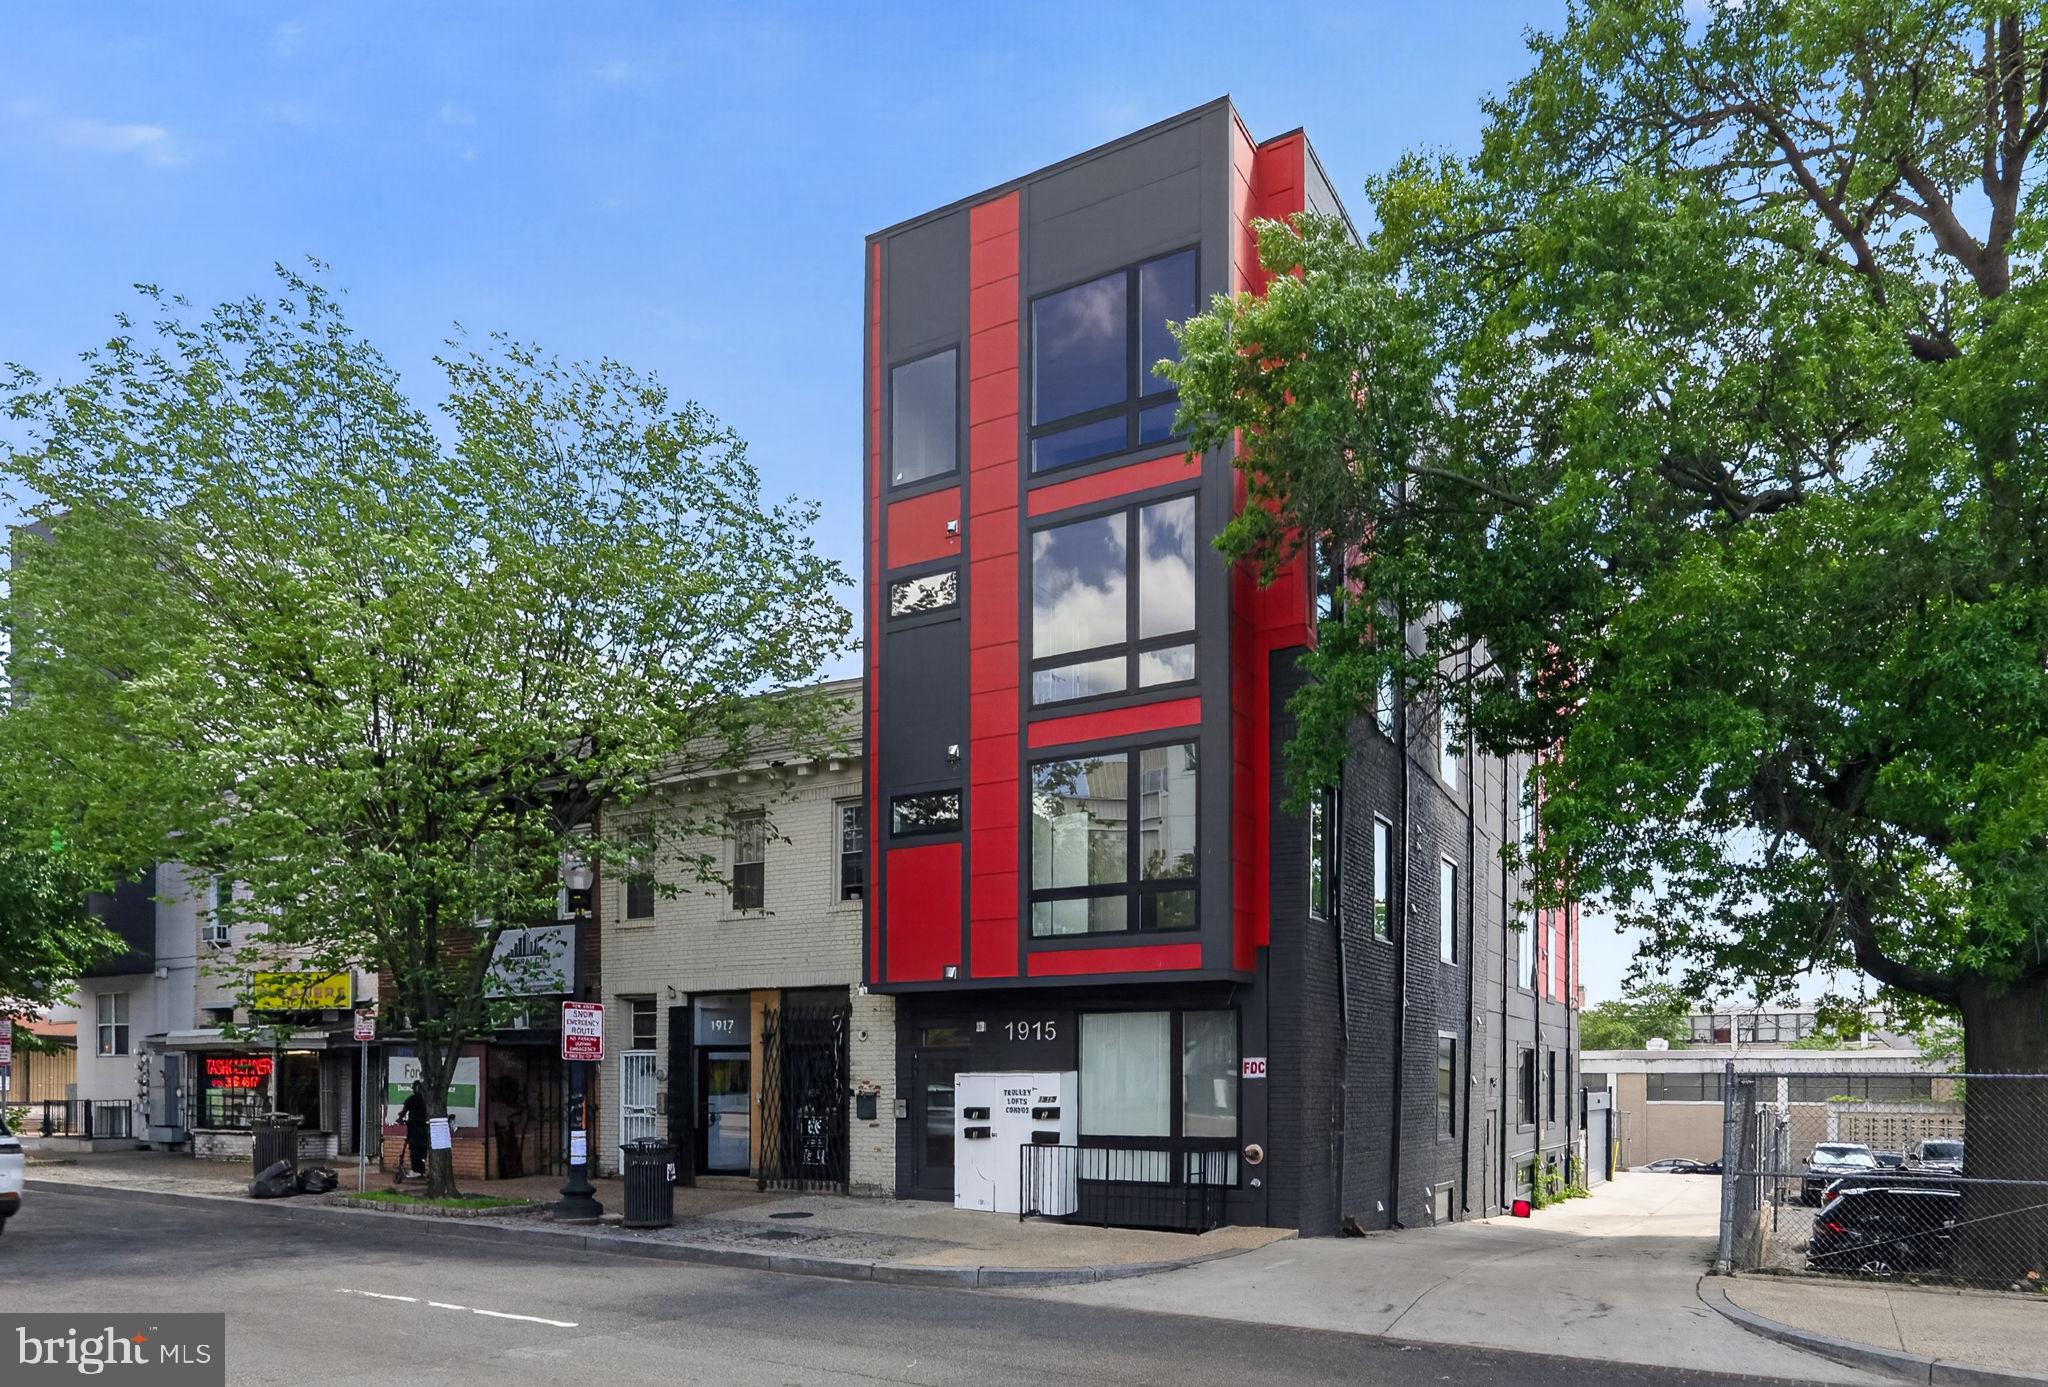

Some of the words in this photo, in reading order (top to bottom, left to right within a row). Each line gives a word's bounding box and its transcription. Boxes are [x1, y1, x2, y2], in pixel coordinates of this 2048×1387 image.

[573, 1010, 594, 1018] SNOW
[567, 1019, 600, 1027] EMERGENCY
[711, 1019, 734, 1033] 1917
[572, 1027, 595, 1036] ROUTE
[1004, 1021, 1057, 1041] 1915
[1244, 1062, 1265, 1075] FDC
[1005, 1106, 1029, 1114] CONDOS
